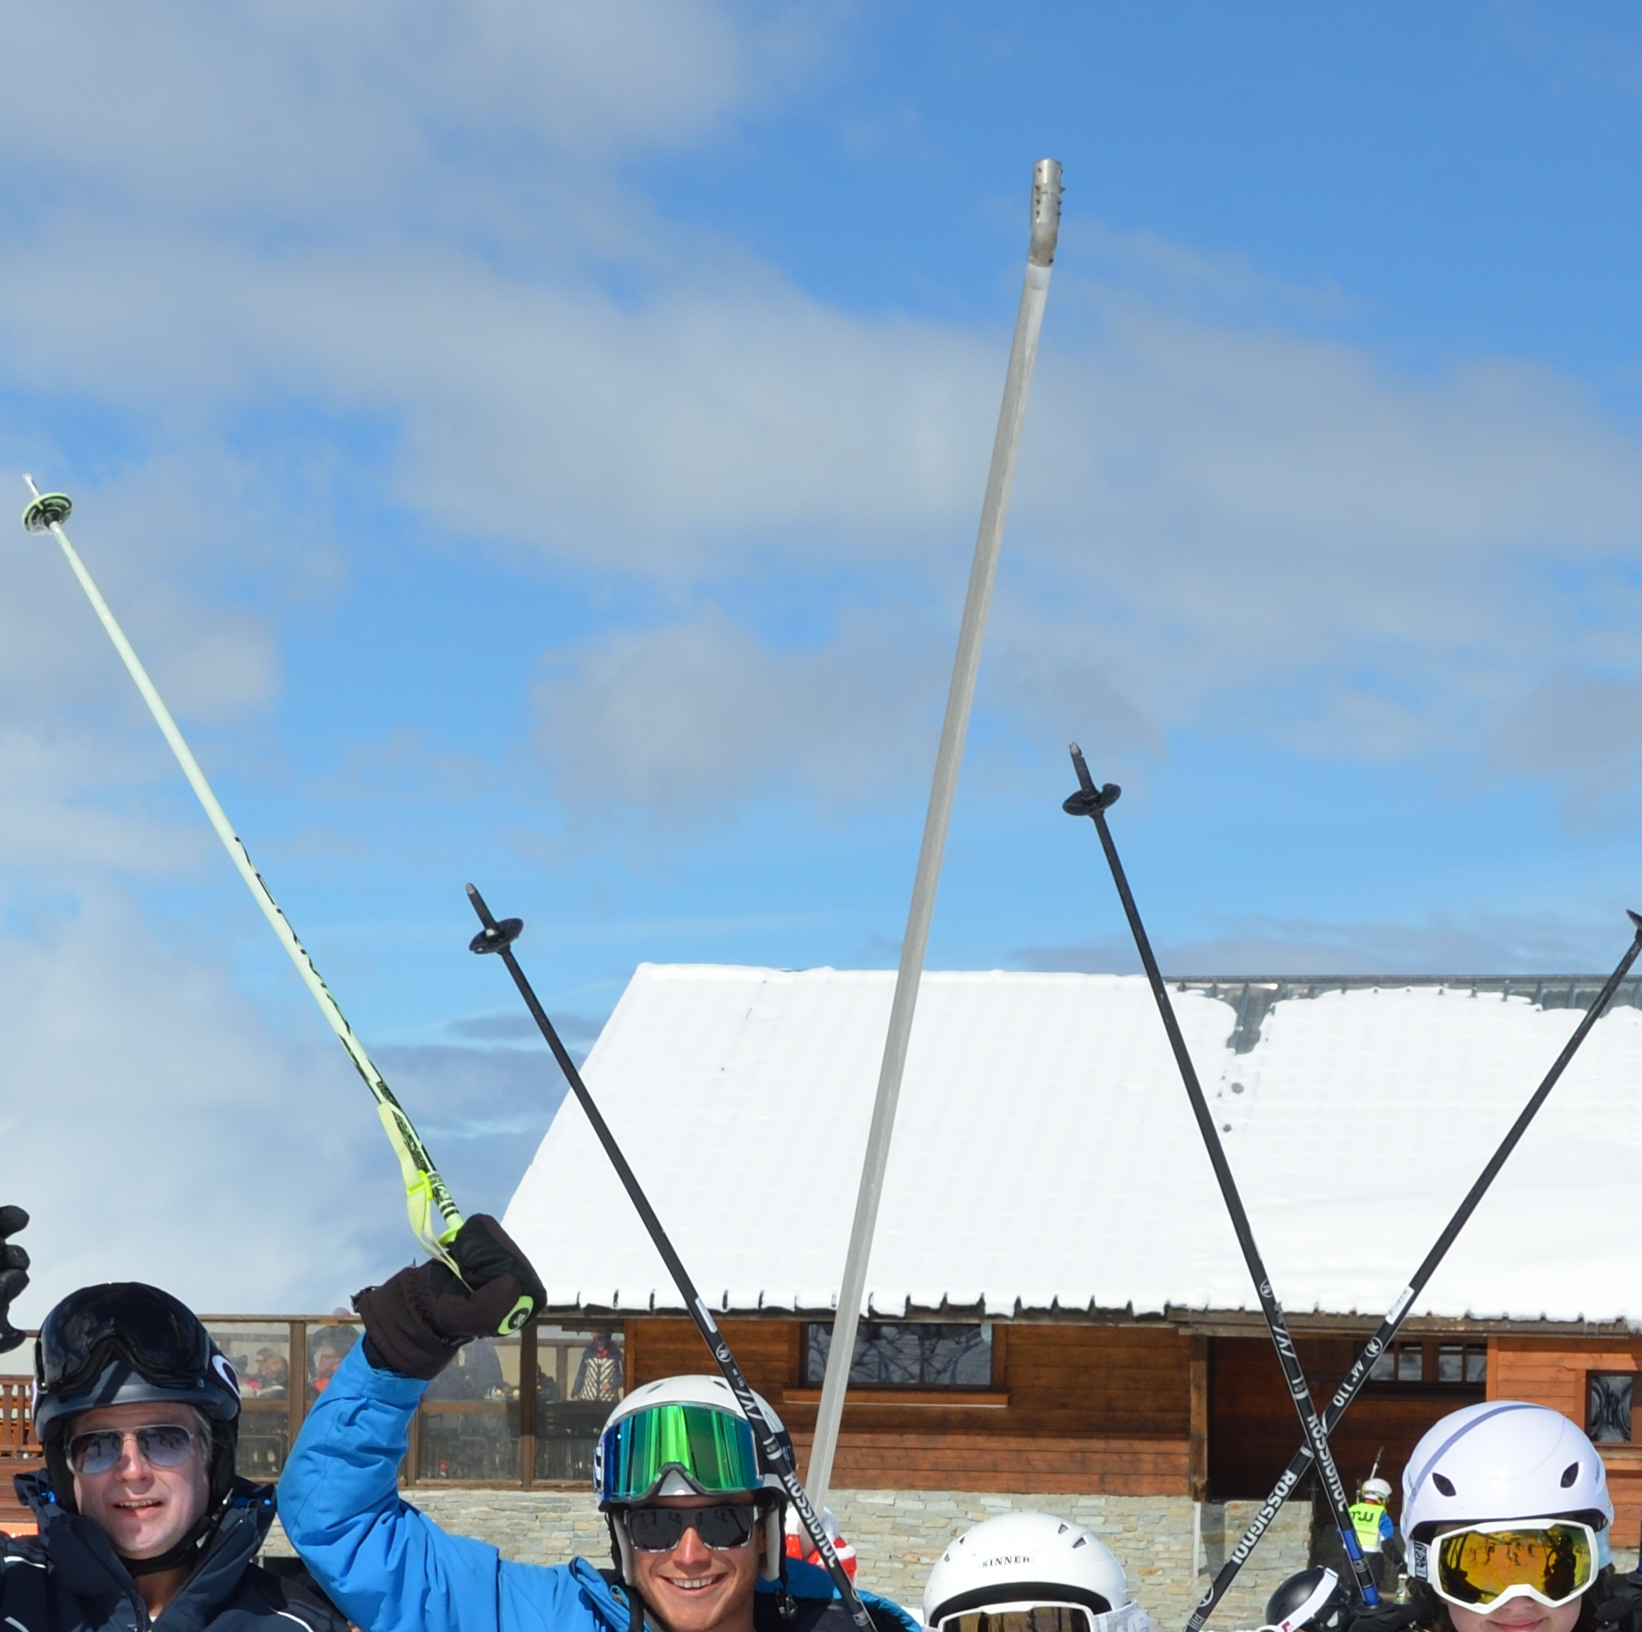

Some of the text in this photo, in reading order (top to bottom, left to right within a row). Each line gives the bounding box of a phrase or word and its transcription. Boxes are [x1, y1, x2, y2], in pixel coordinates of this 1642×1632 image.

[1304, 1414, 1349, 1512] ROSSIGNOL
[782, 1471, 840, 1568] ROSSIGNOL
[981, 1556, 1031, 1568] SINNER
[1229, 1468, 1298, 1566] ROSSIGNOL
